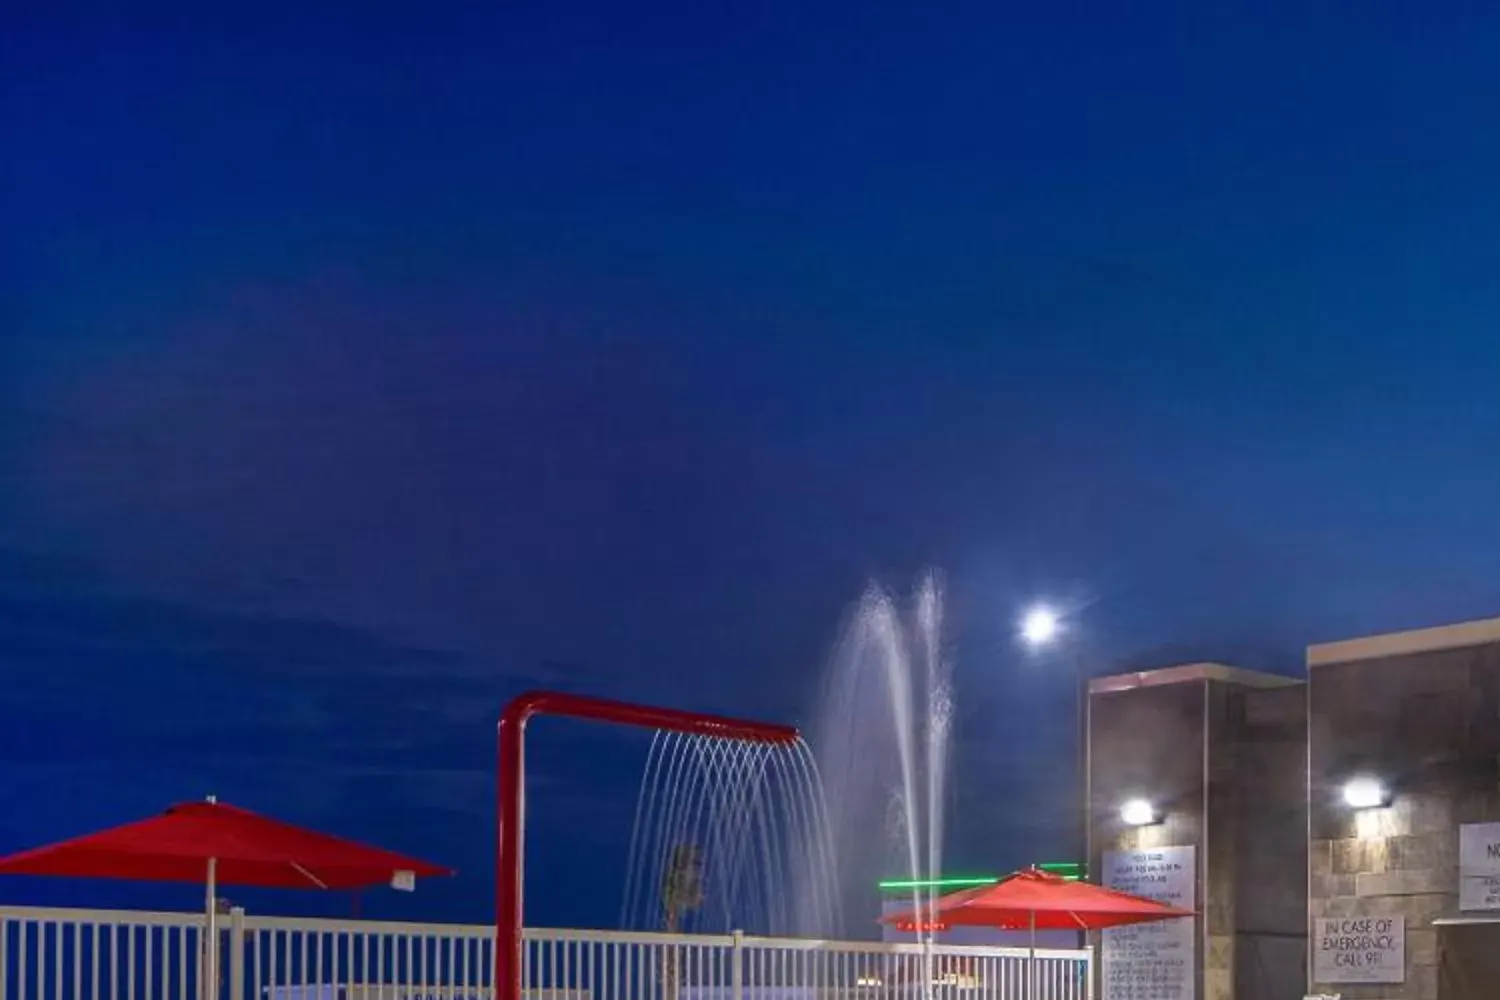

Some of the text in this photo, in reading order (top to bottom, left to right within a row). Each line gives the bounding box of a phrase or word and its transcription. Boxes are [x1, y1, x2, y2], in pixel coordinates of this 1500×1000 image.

[1325, 919, 1393, 934] IN CASE OF
[1336, 952, 1362, 967] CALL
